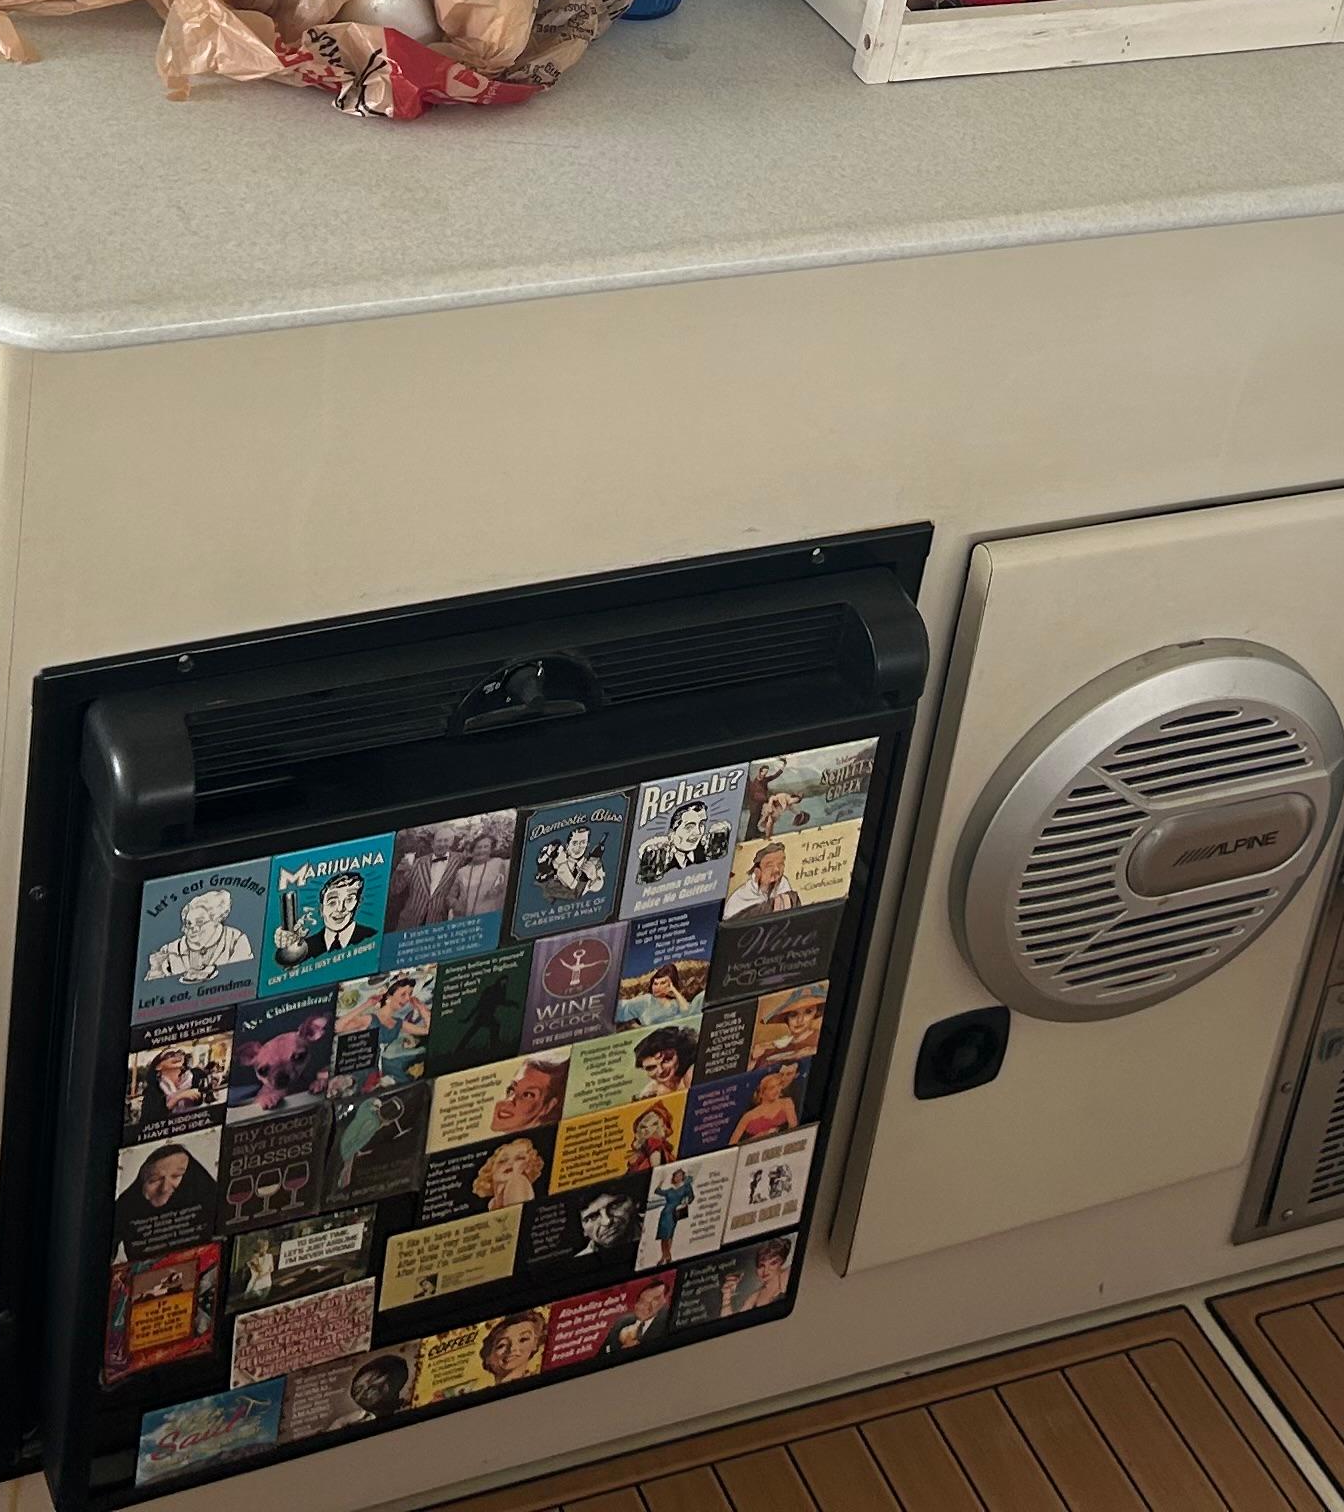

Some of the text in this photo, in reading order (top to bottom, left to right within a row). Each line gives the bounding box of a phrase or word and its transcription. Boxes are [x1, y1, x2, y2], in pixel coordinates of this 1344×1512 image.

[640, 770, 744, 827] Rehab?
[530, 808, 622, 840] Domestic Bliss
[812, 837, 844, 849] never
[1196, 831, 1279, 862] ALPINE
[802, 846, 840, 865] said all
[279, 852, 384, 890] MARIJUANA
[796, 868, 818, 880] that
[146, 874, 266, 918] Let's eat Grandma
[558, 900, 590, 912] BOTTLE
[524, 912, 572, 928] CABERNET
[138, 995, 164, 1009] Let's
[536, 994, 605, 1020] WINE
[154, 1026, 174, 1036] DAY
[176, 1015, 222, 1029] WITHOUT
[533, 1013, 601, 1034] O'CLOCK
[151, 1035, 177, 1045] WINE
[143, 1120, 166, 1132] JUST
[143, 1127, 169, 1139] HAVE
[171, 1125, 186, 1133] NO
[230, 1142, 313, 1176] glasses
[559, 1301, 602, 1319] Alcoholics
[557, 1320, 572, 1329] run
